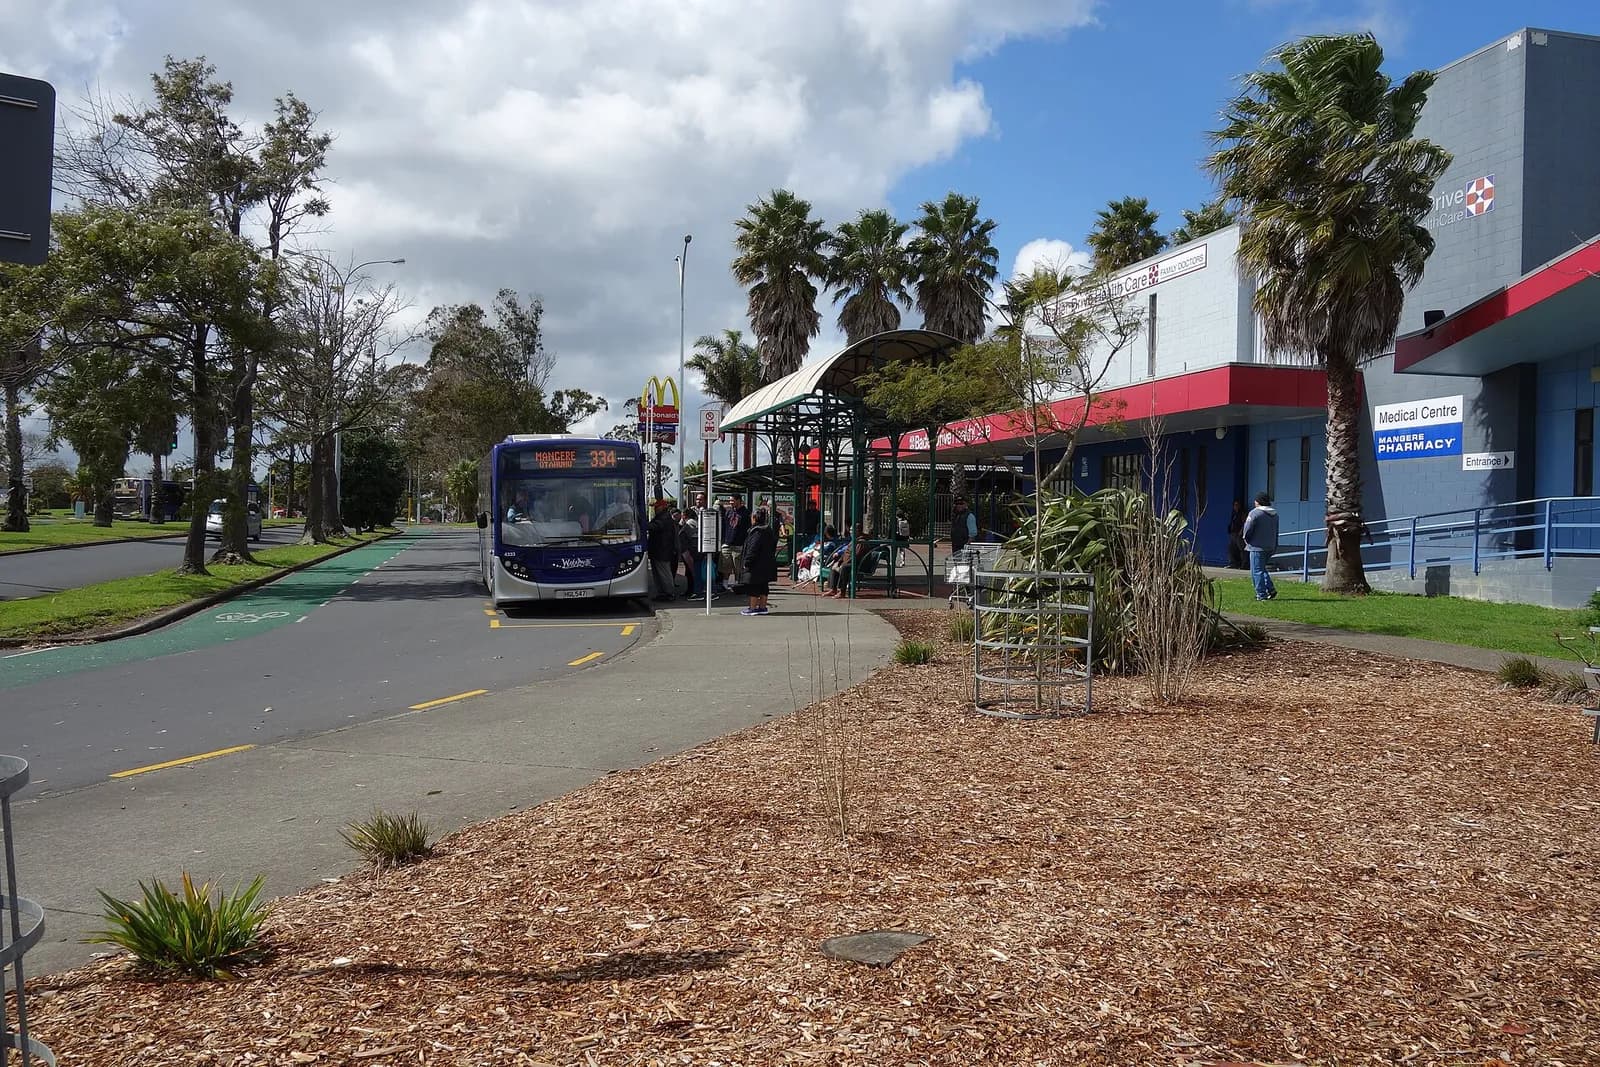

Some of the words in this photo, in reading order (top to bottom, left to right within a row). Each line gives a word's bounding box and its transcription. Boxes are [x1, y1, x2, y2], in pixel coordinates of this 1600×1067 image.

[1160, 265, 1178, 276] FAMILY
[1179, 254, 1204, 271] DOCTORS
[1095, 282, 1123, 306] Helth
[1124, 274, 1148, 292] Care
[1042, 367, 1072, 376] entre
[1379, 408, 1418, 424] Medical
[1421, 404, 1457, 420] Centre
[1378, 438, 1454, 453] PHARMACY
[1379, 433, 1425, 444] MANGERE
[535, 451, 576, 461] MANGERE
[590, 450, 616, 468] 334
[1466, 456, 1501, 467] Entrance
